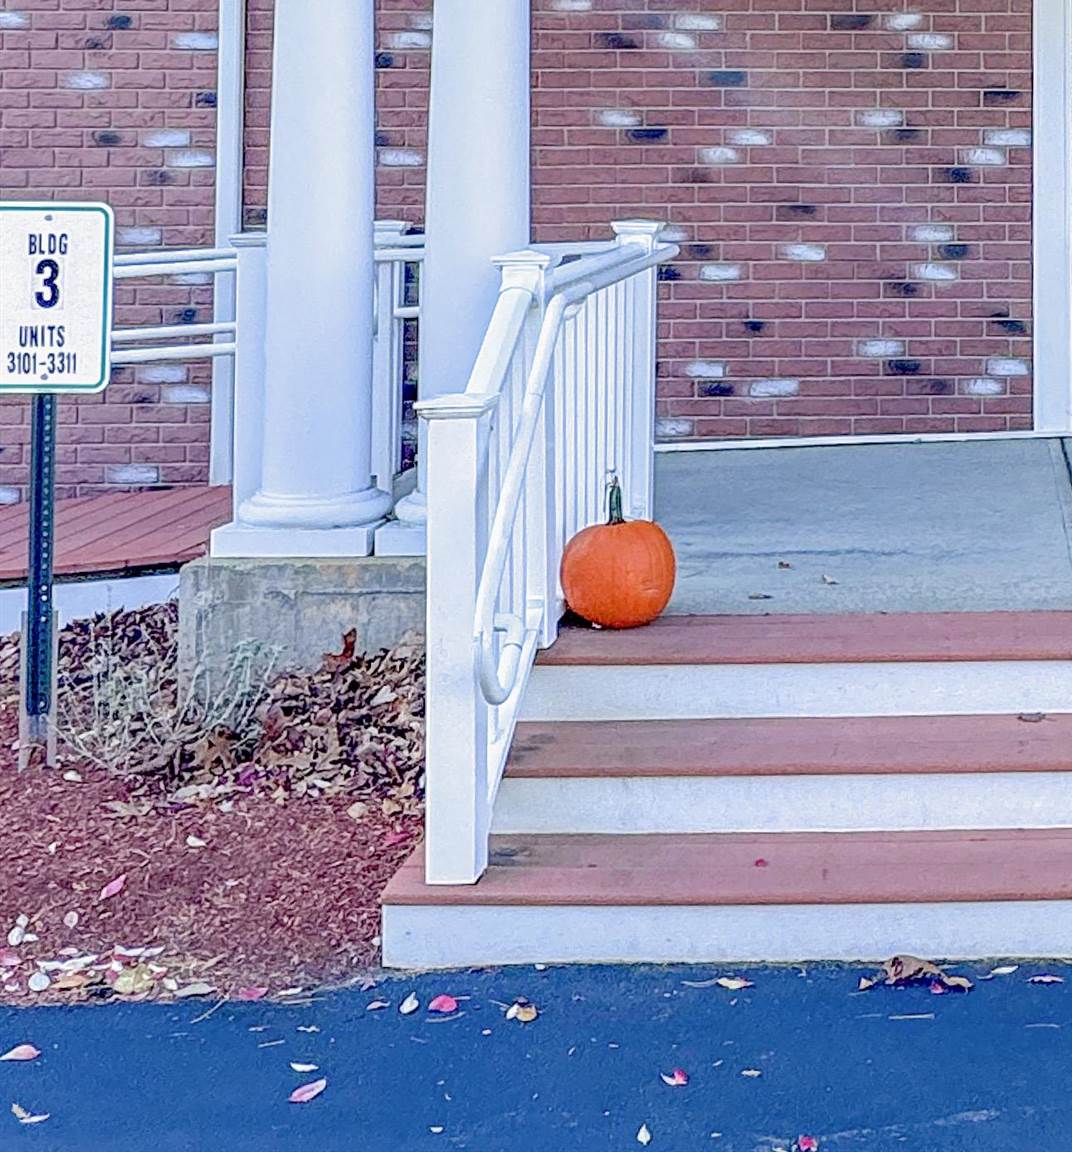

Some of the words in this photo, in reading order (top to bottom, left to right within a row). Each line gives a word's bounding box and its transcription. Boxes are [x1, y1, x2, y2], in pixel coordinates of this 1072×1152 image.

[28, 233, 68, 255] BLDG
[35, 258, 60, 308] 3
[19, 325, 66, 347] UNITS
[7, 351, 77, 374] 3101-3311
